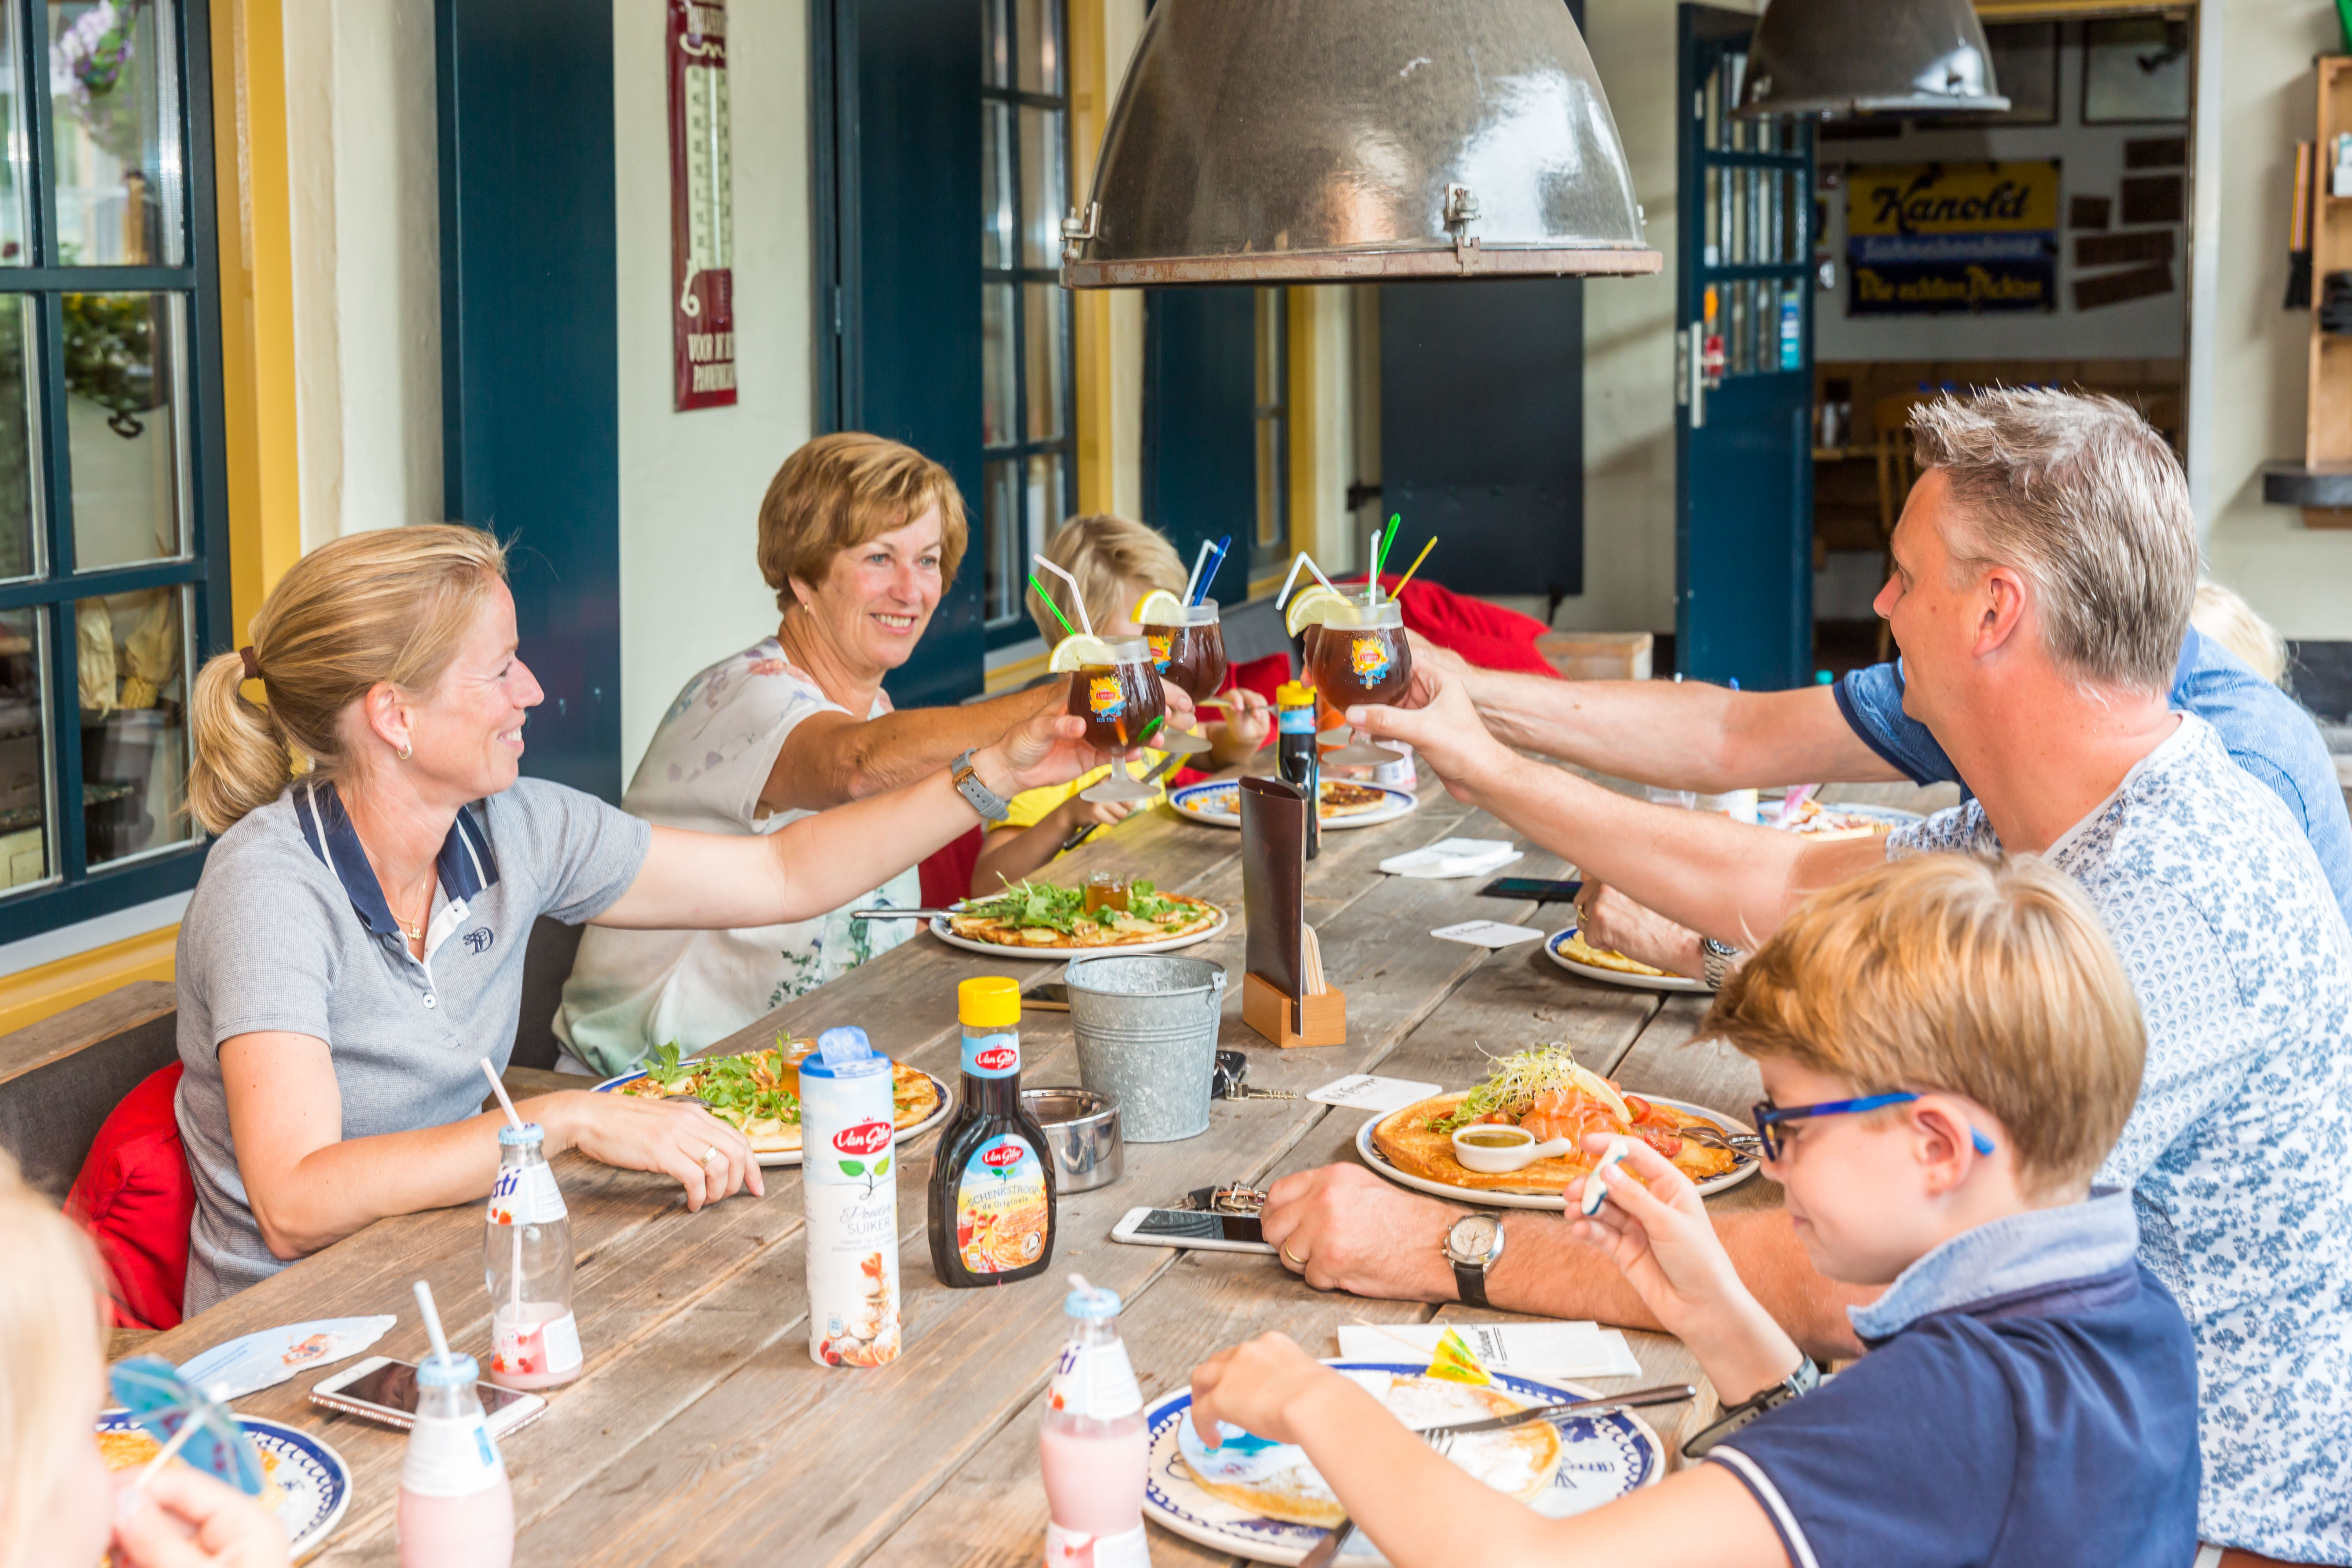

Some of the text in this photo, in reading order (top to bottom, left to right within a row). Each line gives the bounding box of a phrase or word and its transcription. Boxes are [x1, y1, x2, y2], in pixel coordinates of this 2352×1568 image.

[1872, 176, 2030, 235] Kanold
[978, 1050, 1016, 1069] Van Gilse
[837, 1130, 864, 1147] Van
[985, 1150, 1001, 1163] Van
[1002, 1147, 1021, 1165] Gilse
[968, 1186, 1039, 1207] SCHENKSTROOP
[994, 1196, 1028, 1208] Originele
[848, 1216, 890, 1235] SUIKER
